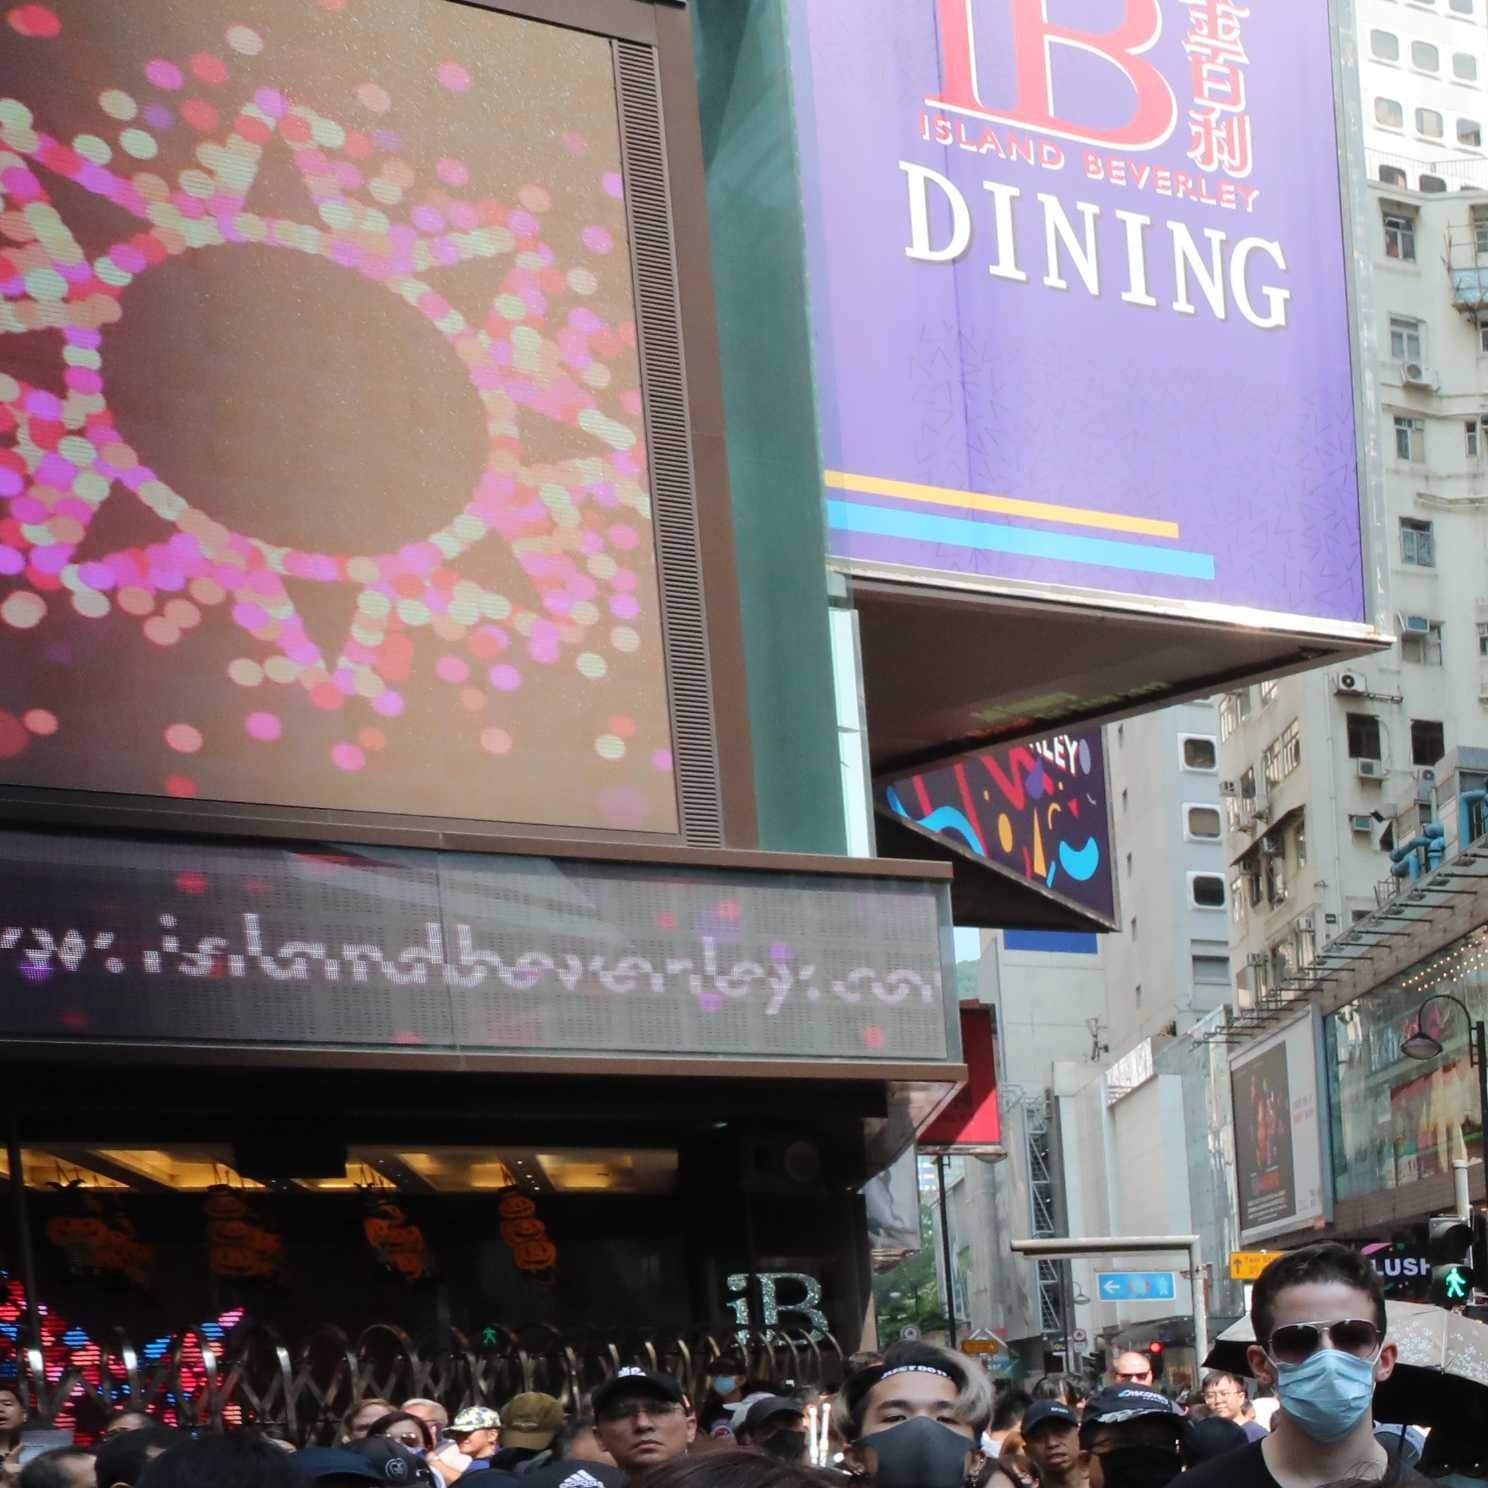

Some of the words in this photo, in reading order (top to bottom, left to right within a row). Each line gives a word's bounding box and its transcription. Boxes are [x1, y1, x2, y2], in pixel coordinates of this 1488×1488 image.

[919, 111, 1065, 170] ISLAND
[1083, 152, 1261, 213] BEVERLEY
[899, 160, 1291, 329] DINING
